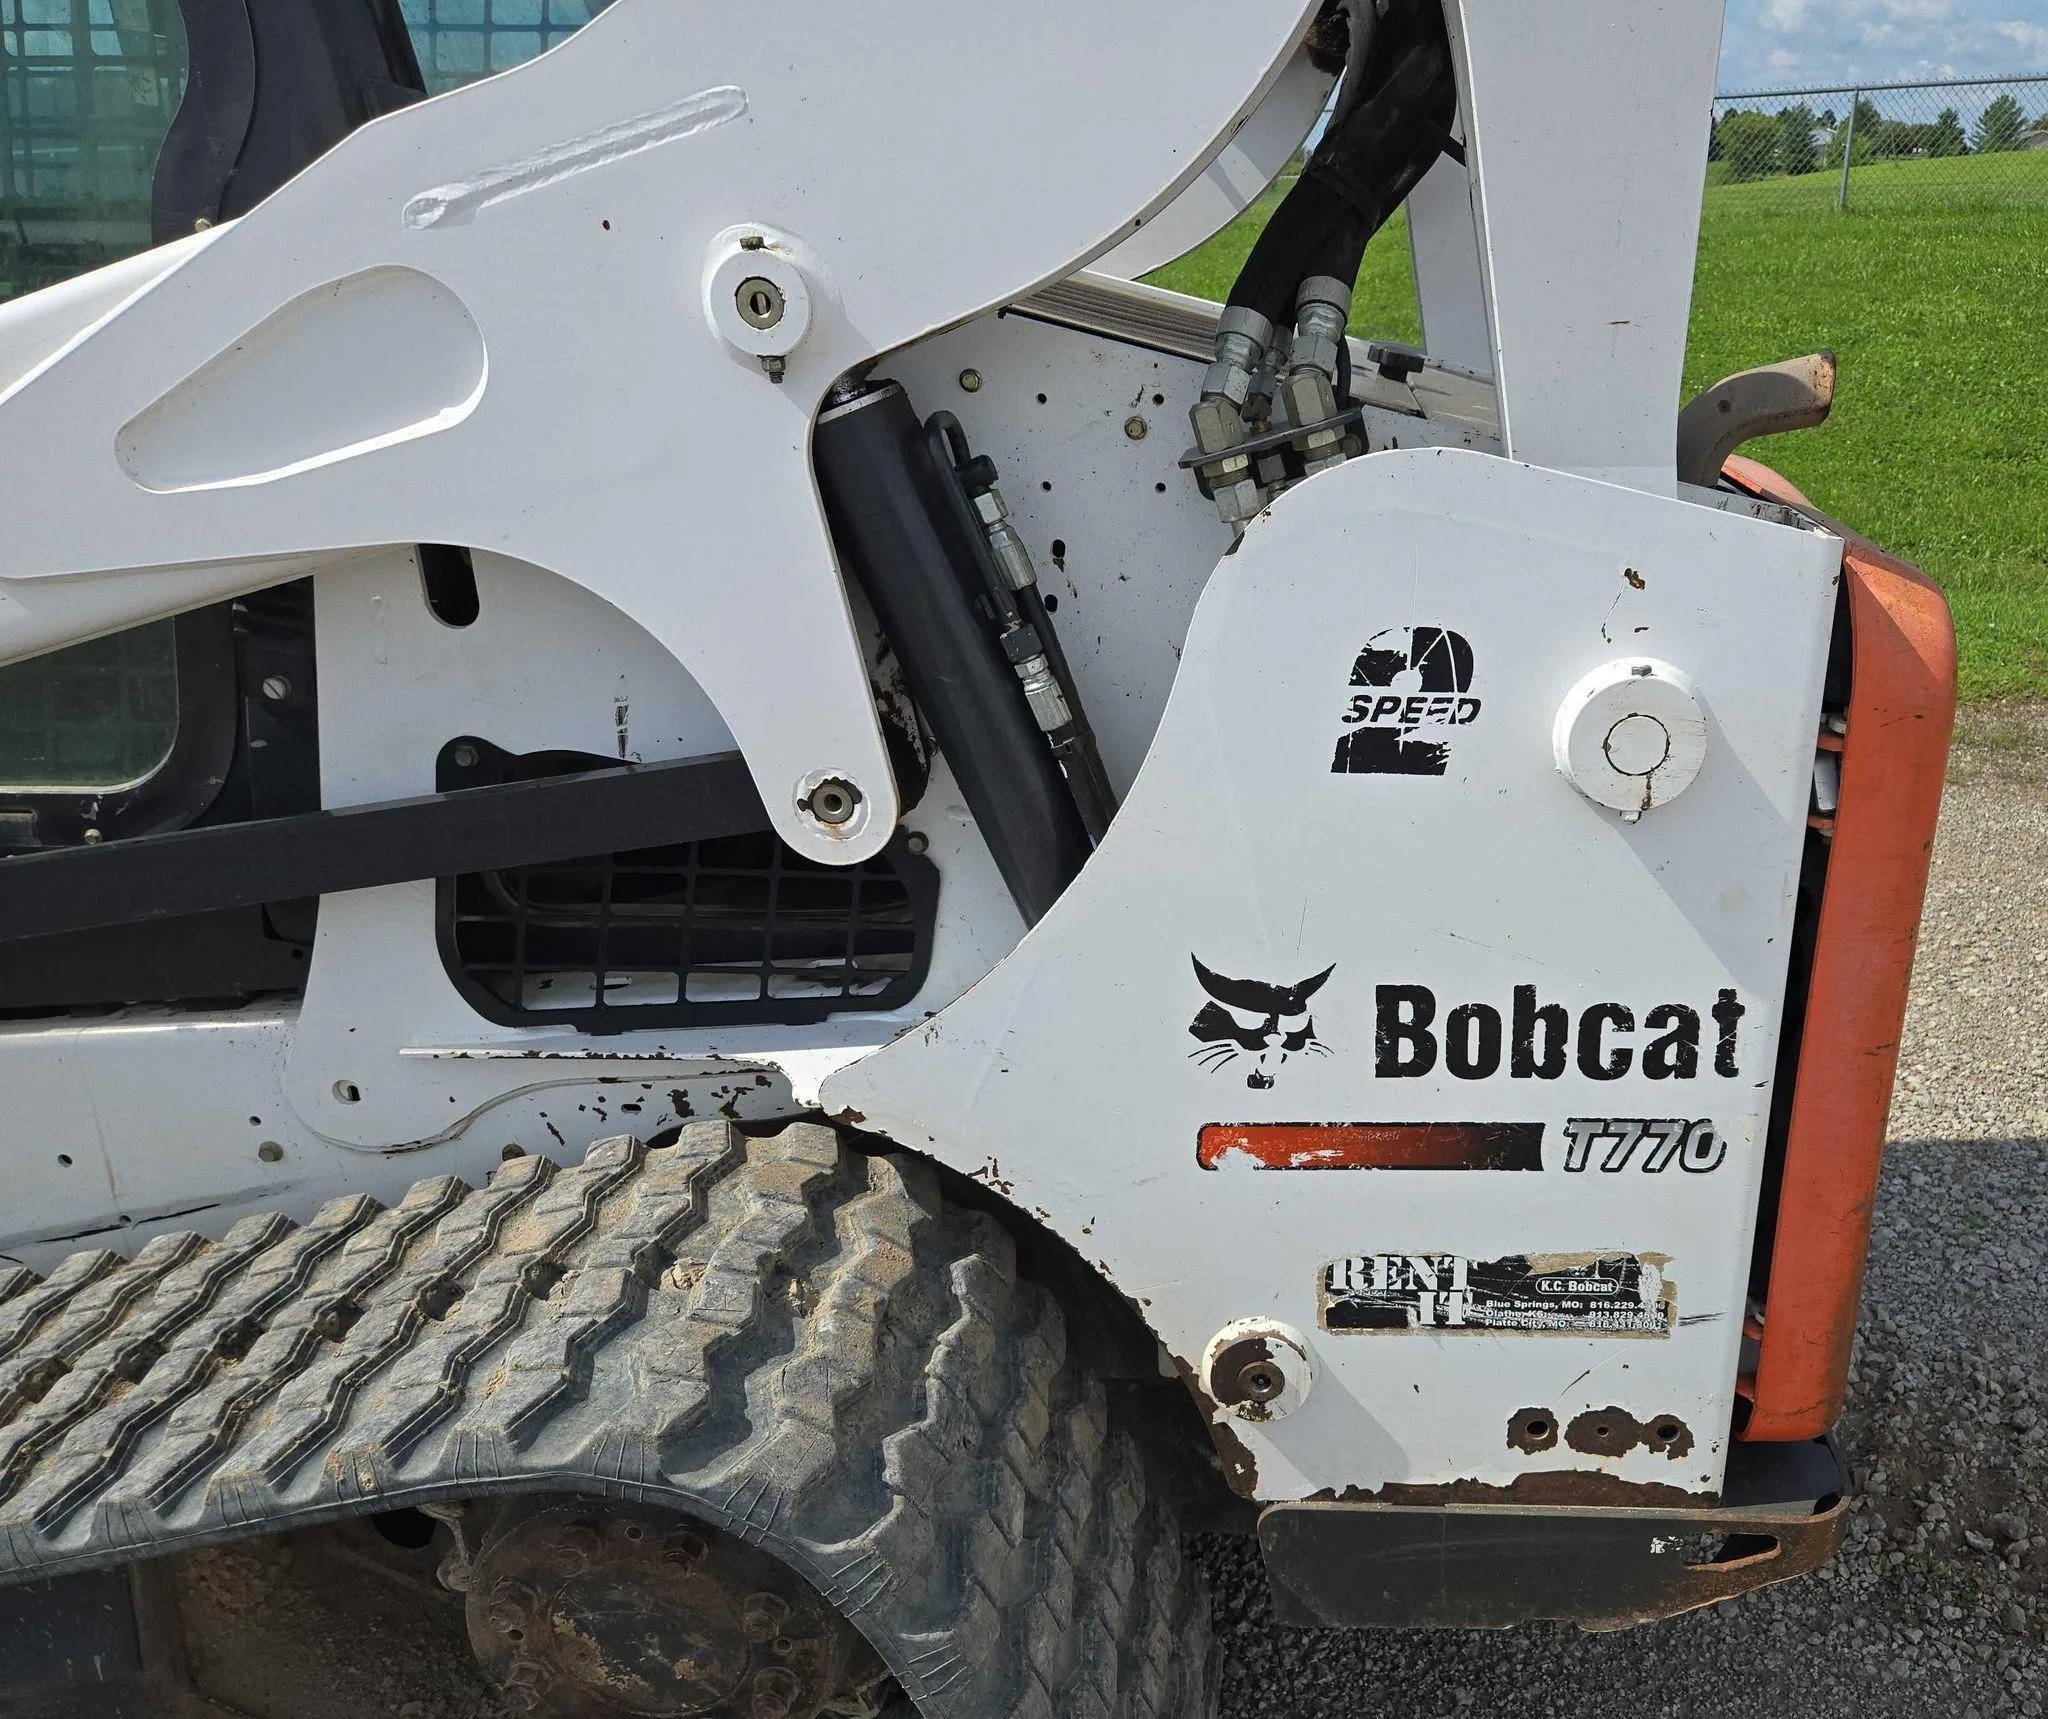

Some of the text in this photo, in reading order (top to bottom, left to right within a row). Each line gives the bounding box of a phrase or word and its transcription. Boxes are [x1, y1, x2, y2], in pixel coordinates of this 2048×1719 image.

[1341, 694, 1482, 725] SPEED
[1375, 984, 1746, 1080] Bobcat
[1563, 1118, 1728, 1174] T770
[1330, 1256, 1478, 1291] RENT
[1541, 1280, 1614, 1292] K.C. Bobcat
[1417, 1292, 1473, 1325] IT
[1486, 1300, 1511, 1308] Blue
[1513, 1300, 1558, 1310] Springs,
[1561, 1300, 1584, 1309] MO:
[1485, 1319, 1518, 1327] Platte
